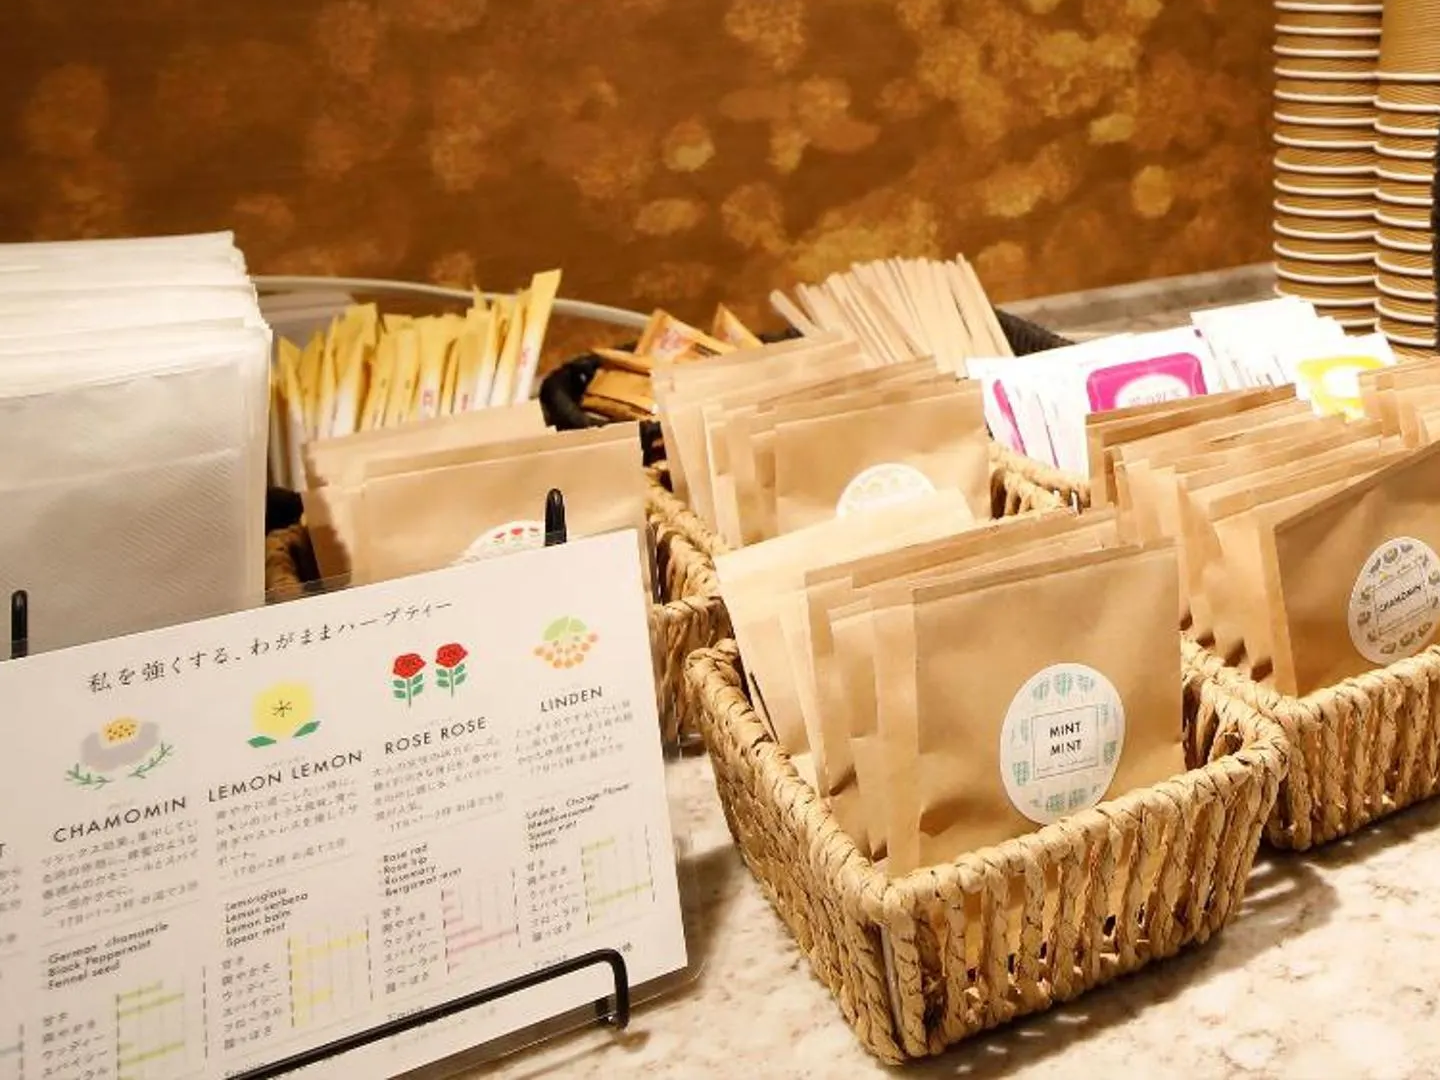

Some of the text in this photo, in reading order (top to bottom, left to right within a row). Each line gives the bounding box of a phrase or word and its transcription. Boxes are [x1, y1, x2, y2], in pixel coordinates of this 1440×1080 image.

[540, 685, 603, 712] LINDEN
[384, 716, 486, 755] ROSE ROSE
[1049, 721, 1082, 738] MINT
[1049, 738, 1082, 757] MINT
[208, 750, 363, 802] LEMON LEMON
[53, 796, 187, 842] CHAMOMIN
